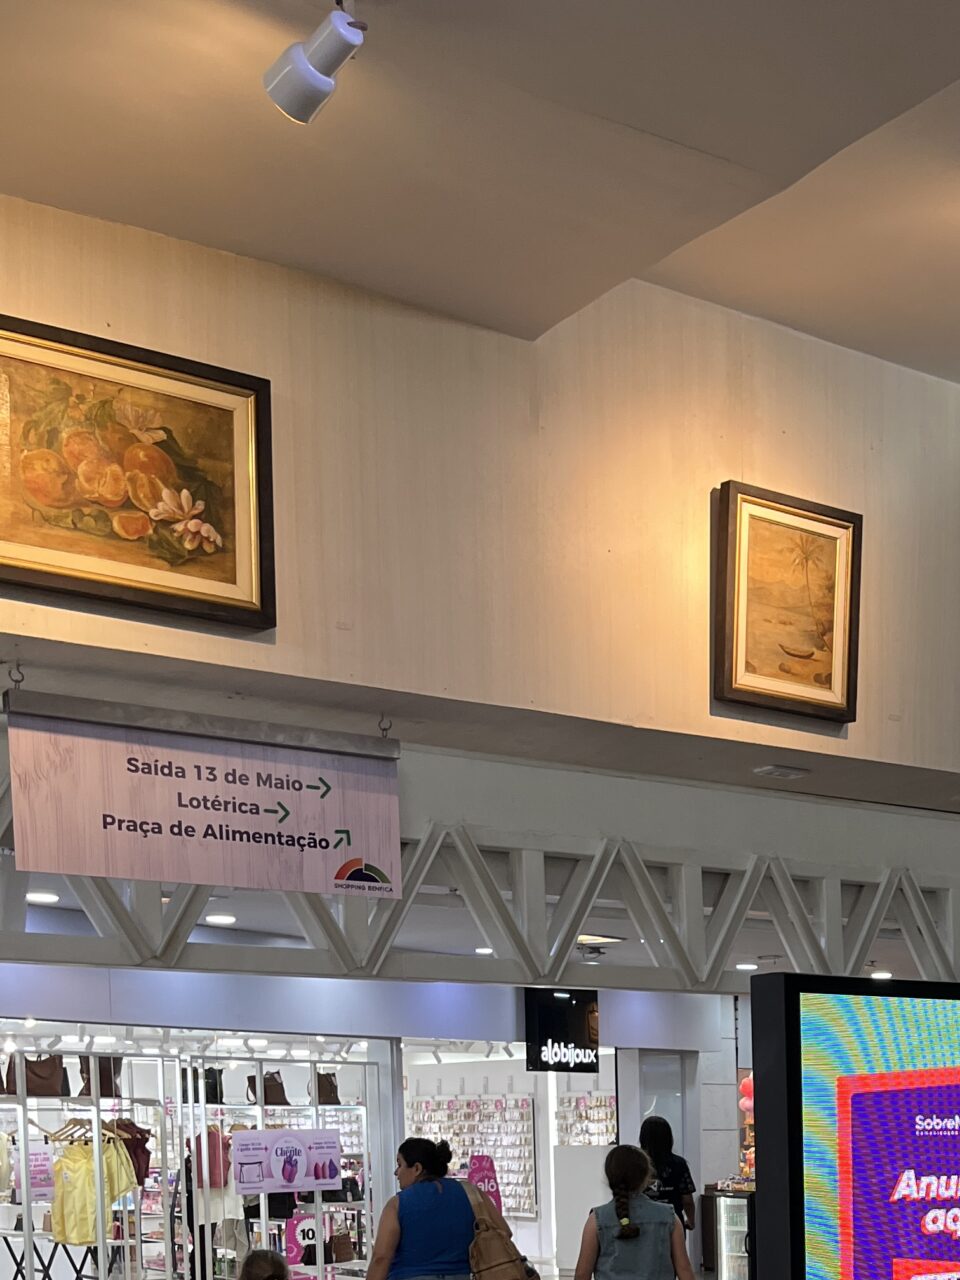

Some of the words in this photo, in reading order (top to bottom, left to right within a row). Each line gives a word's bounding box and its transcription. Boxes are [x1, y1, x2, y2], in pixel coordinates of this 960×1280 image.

[126, 757, 186, 779] Saída
[193, 764, 218, 783] 13
[224, 768, 250, 786] de
[256, 772, 304, 792] Maio
[177, 791, 261, 816] Lotérica
[102, 813, 163, 839] Praça
[169, 820, 196, 838] de
[202, 823, 330, 852] Alimentação
[334, 882, 366, 891] SHOPPING
[367, 884, 394, 893] BENFICA
[541, 1038, 597, 1068] alôbijoux
